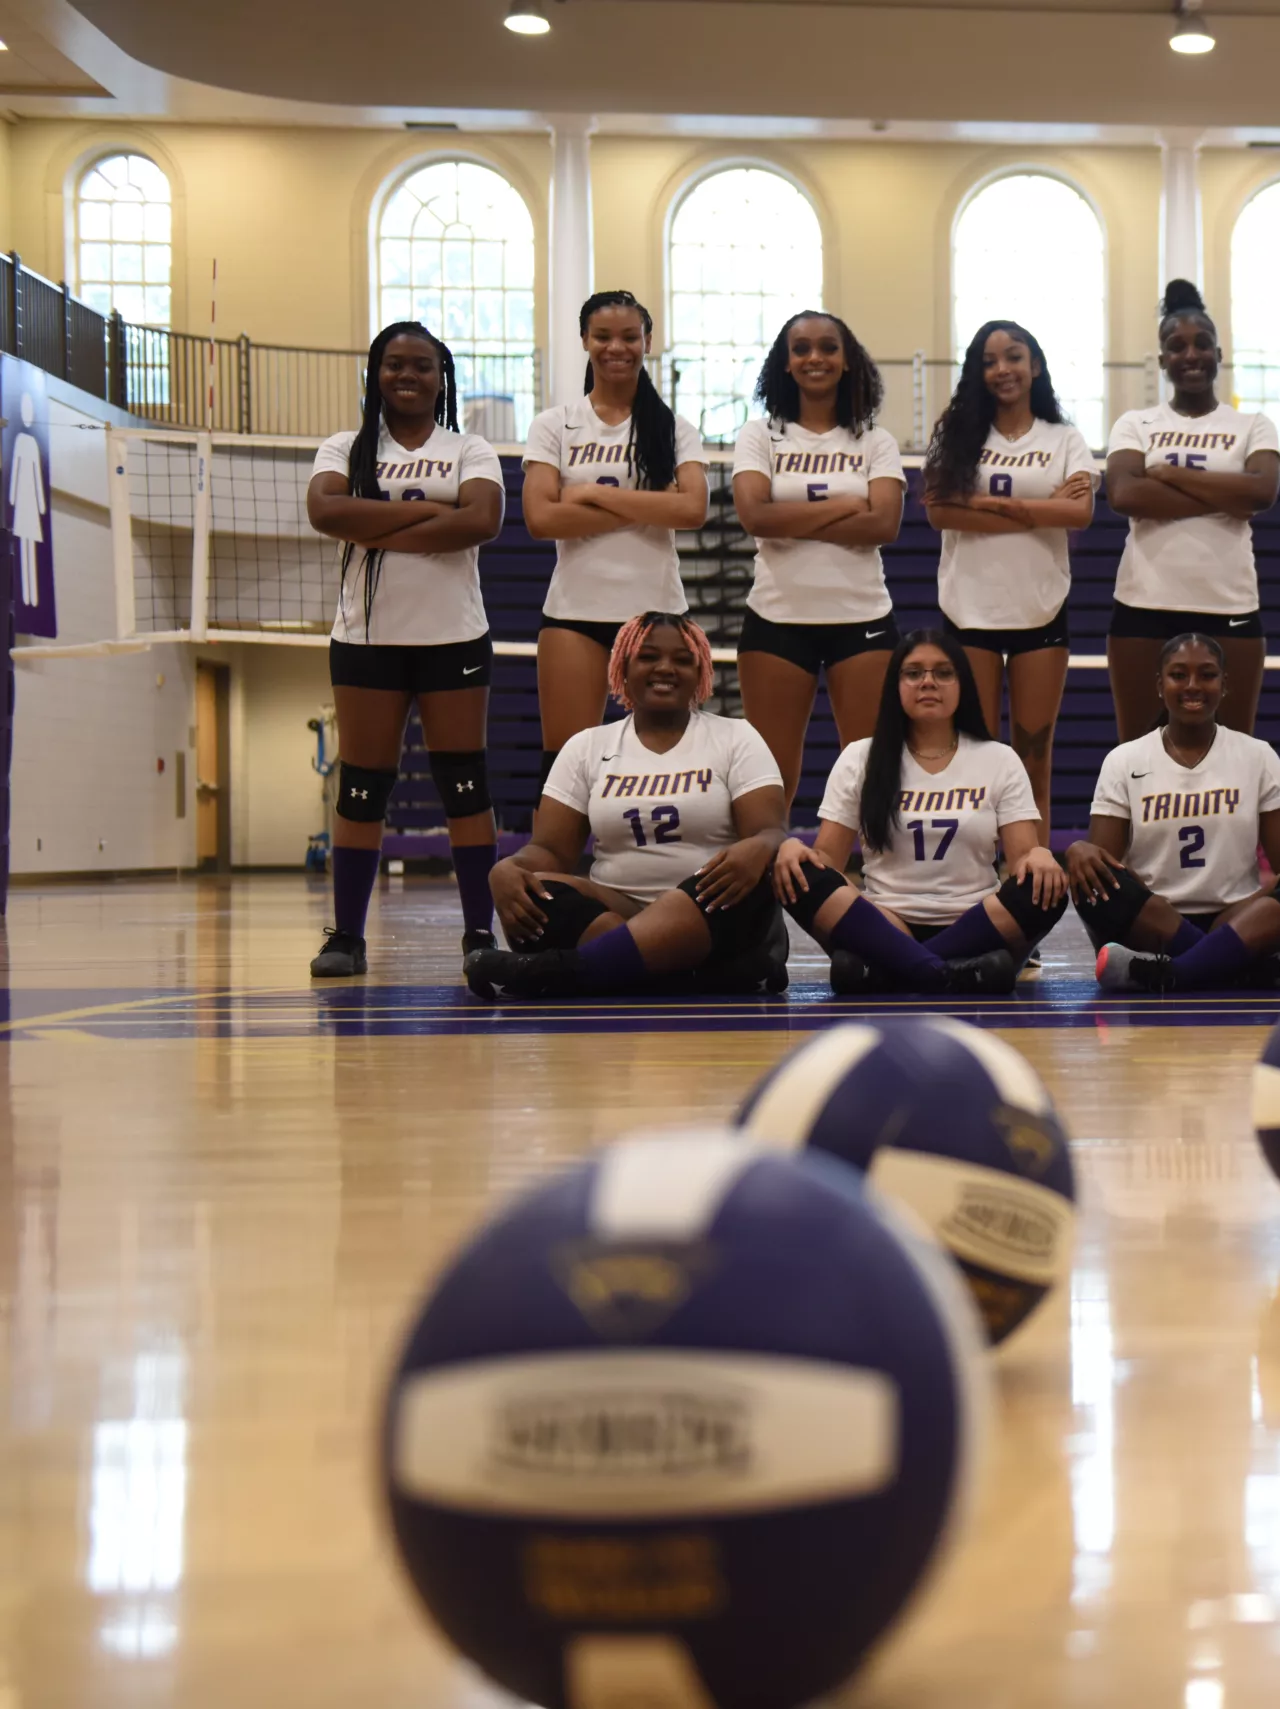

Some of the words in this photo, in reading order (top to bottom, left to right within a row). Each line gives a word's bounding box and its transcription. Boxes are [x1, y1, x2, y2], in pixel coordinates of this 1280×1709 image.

[567, 441, 640, 467] TRIN
[1148, 430, 1238, 452] TRINITY
[375, 458, 453, 479] RINITY
[774, 451, 864, 475] TRINITY
[979, 448, 1052, 468] RINITY
[600, 768, 713, 799] TRINITY
[899, 786, 987, 812] RINITY
[1141, 788, 1240, 823] TRINITY
[622, 804, 682, 847] 12
[906, 818, 959, 862] 17
[1178, 825, 1206, 869] 2
